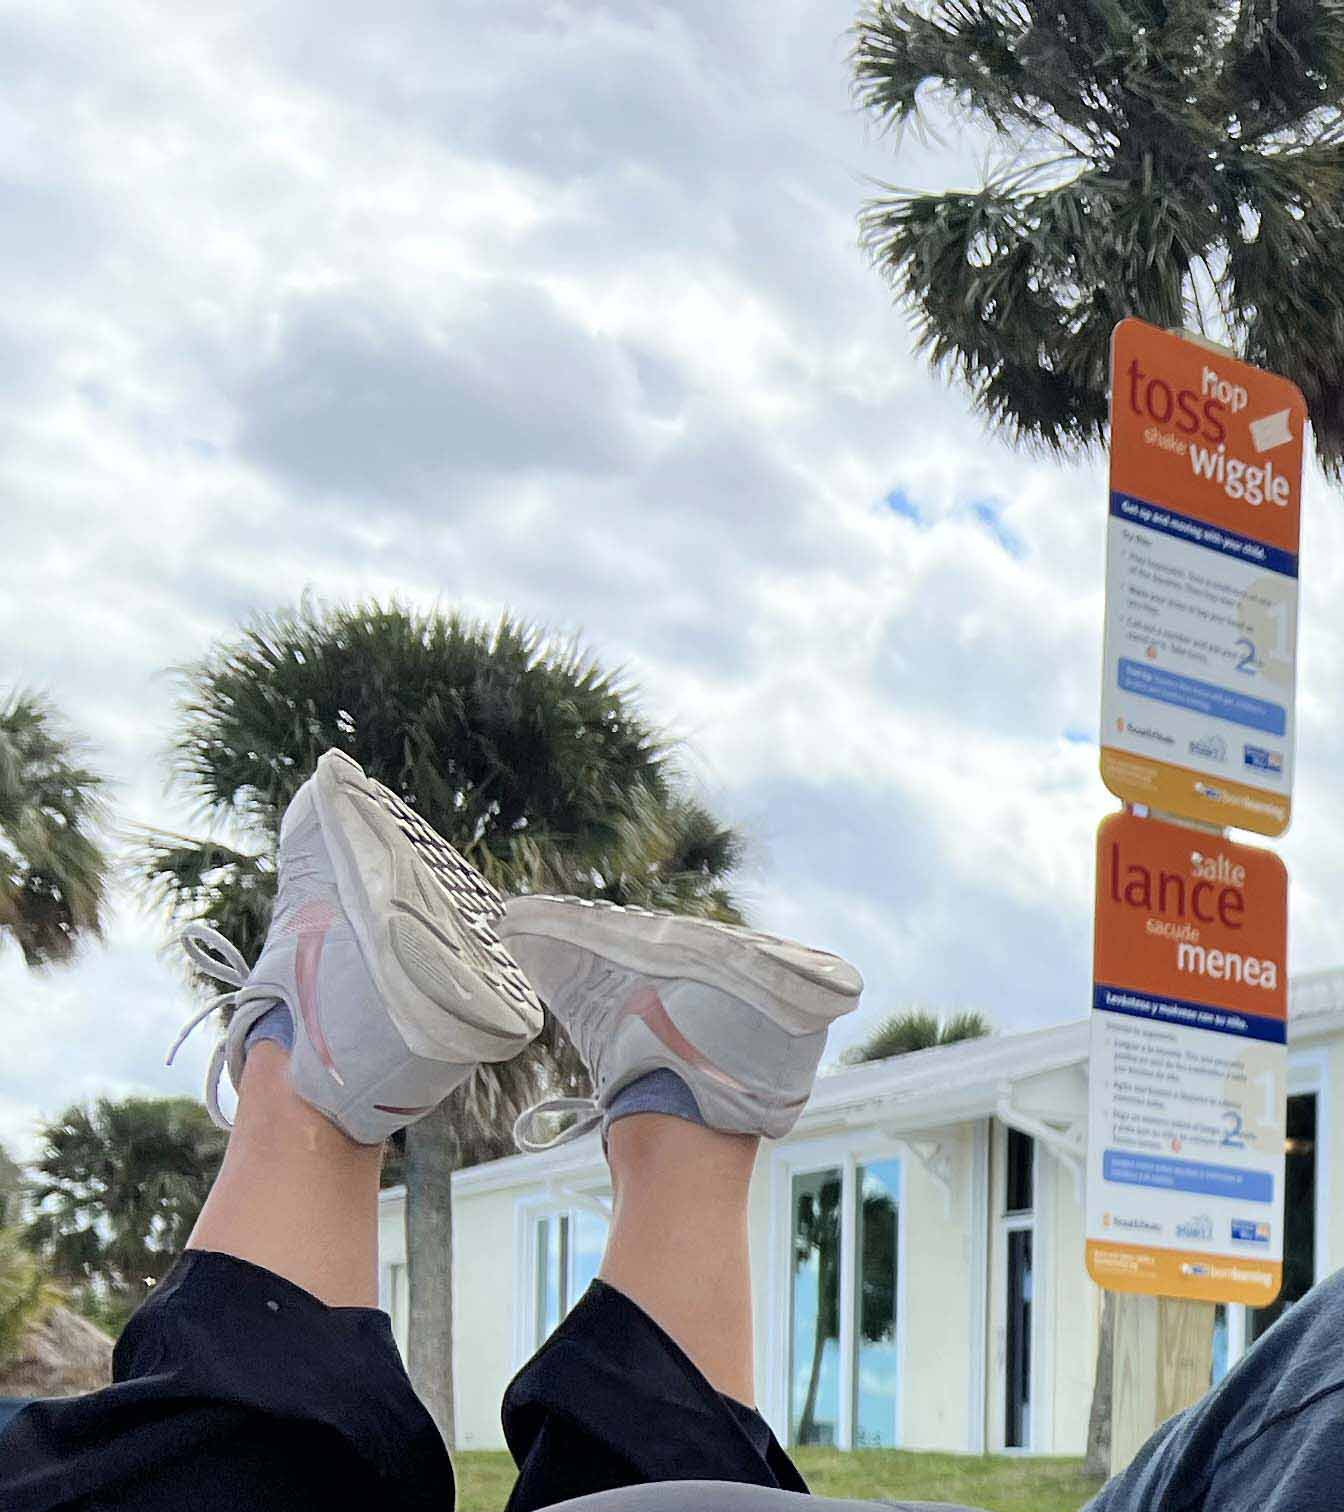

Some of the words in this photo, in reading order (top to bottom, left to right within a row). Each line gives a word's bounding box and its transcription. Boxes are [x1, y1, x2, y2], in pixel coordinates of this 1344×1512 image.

[1128, 359, 1226, 444] toss
[1202, 366, 1248, 412] hop
[1189, 443, 1290, 506] wiggle
[1110, 842, 1244, 929] lance
[1191, 851, 1245, 887] salte
[1146, 918, 1200, 943] sacude
[1177, 942, 1278, 991] menea
[1222, 1111, 1245, 1149] 2
